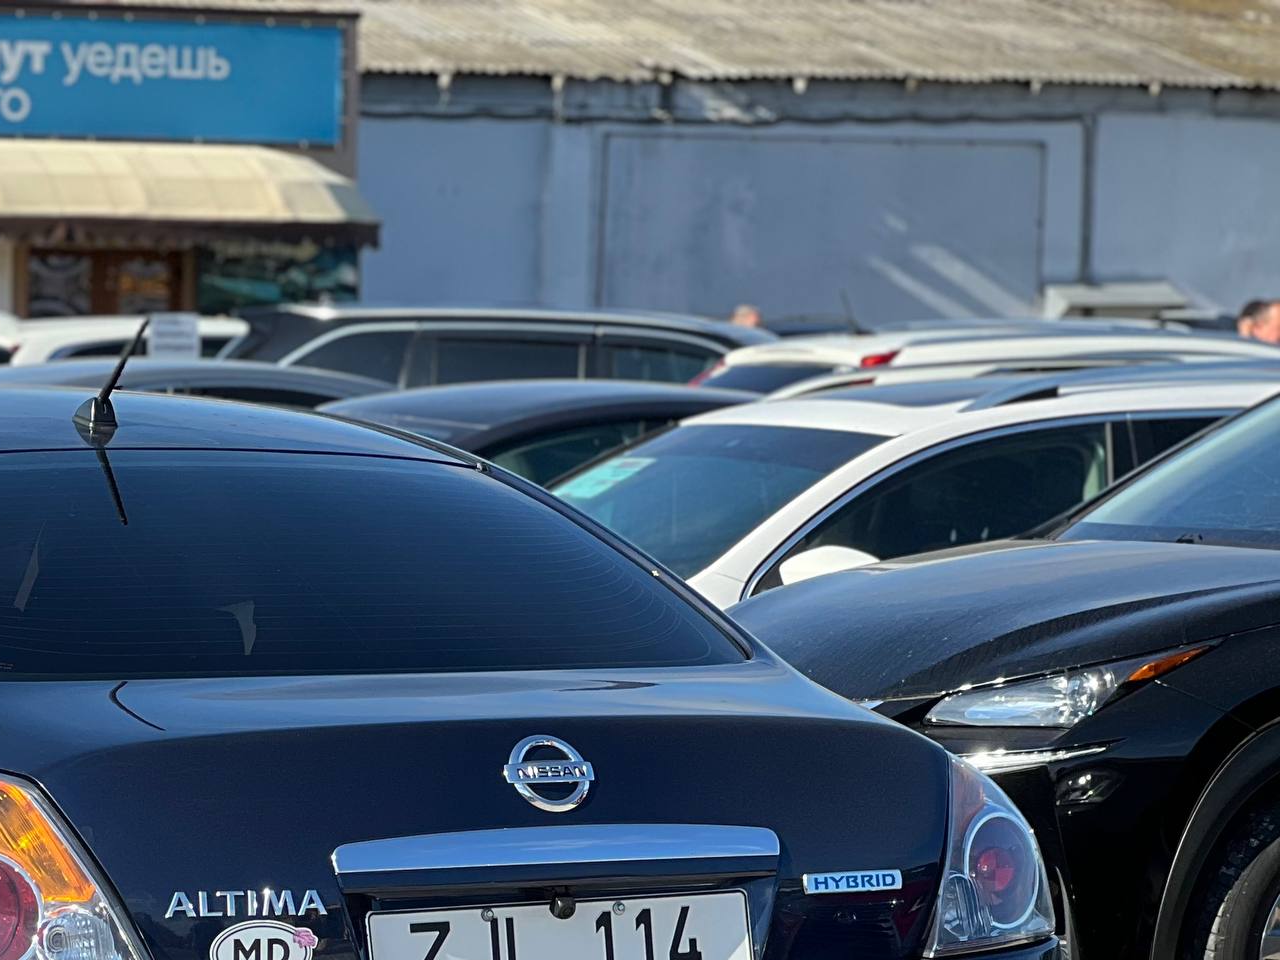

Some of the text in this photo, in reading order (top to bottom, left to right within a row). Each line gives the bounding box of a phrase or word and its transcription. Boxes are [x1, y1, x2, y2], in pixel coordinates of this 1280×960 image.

[60, 41, 232, 86] уедешь
[517, 765, 587, 779] NISSAN
[814, 873, 896, 890] HYBRID
[164, 888, 329, 919] ALTIMA
